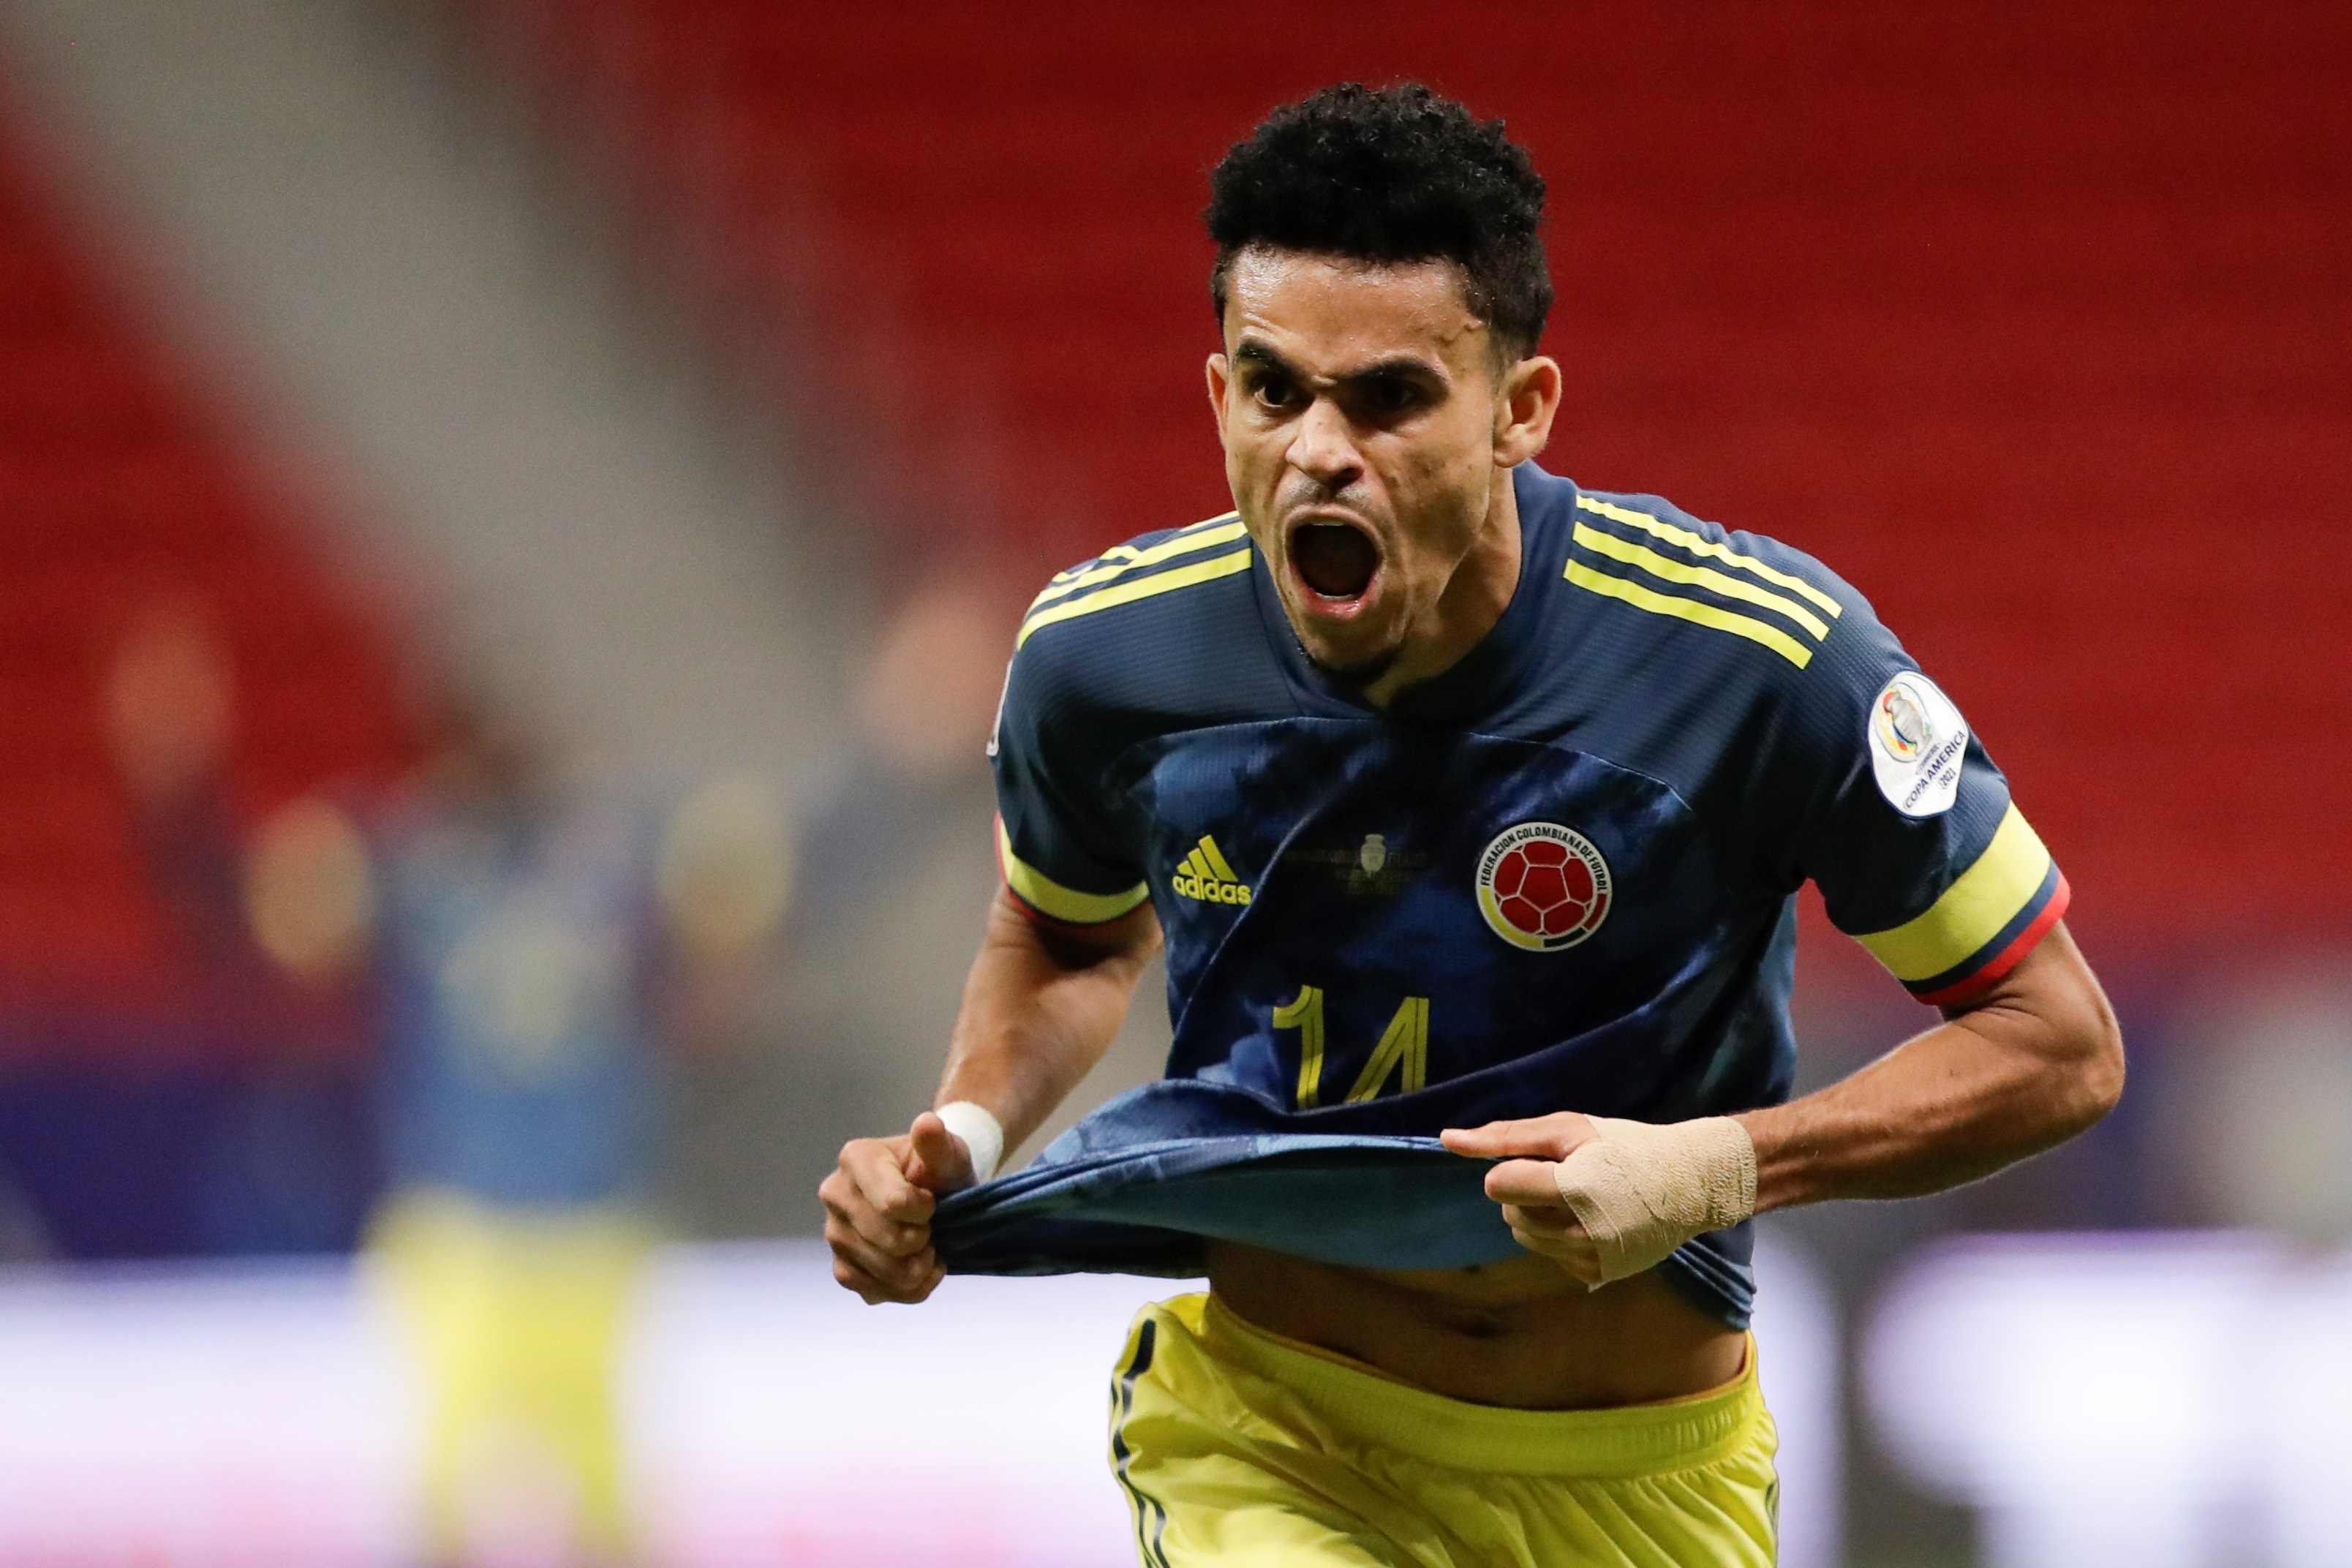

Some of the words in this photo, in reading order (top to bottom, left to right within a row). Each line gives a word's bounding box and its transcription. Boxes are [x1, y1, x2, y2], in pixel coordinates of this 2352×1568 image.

[1940, 768, 1956, 786] 2021
[1905, 778, 1928, 808] COPA
[1480, 833, 1516, 886] FEDERACION
[1516, 826, 1581, 849] COLOMBIANA
[1580, 845, 1593, 859] DE
[1588, 856, 1607, 891] FUTBOL
[1172, 875, 1251, 905] adidas
[1273, 984, 1430, 1109] 14
